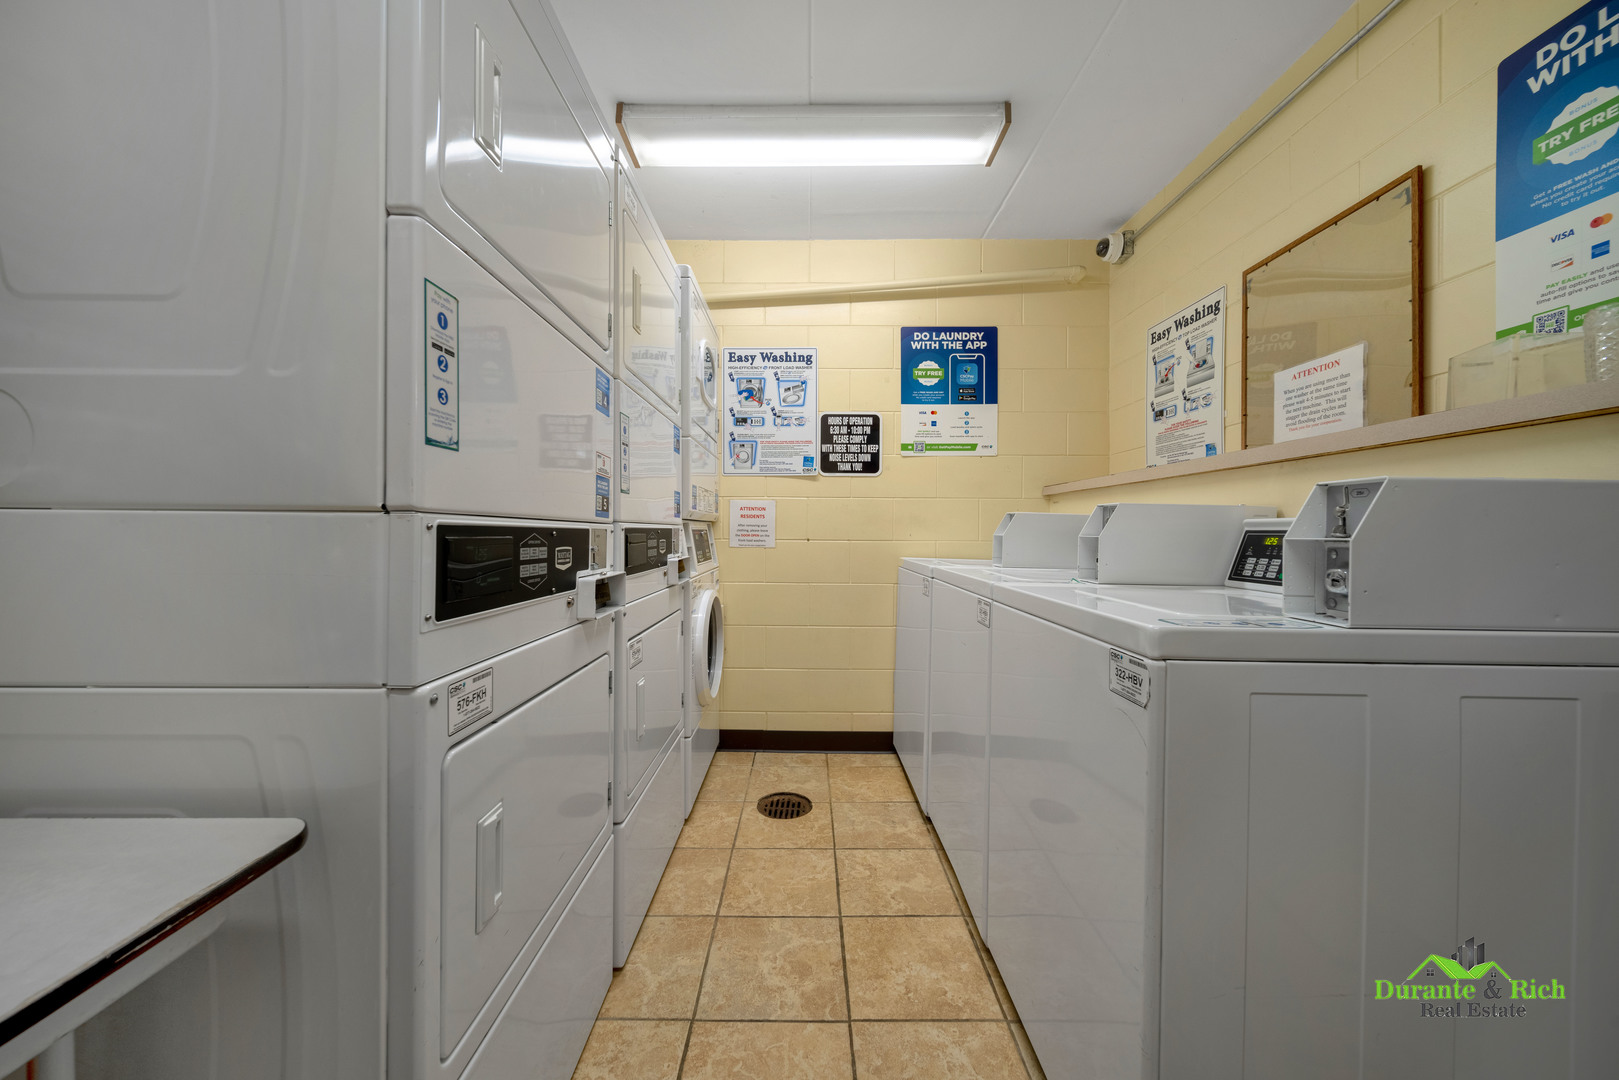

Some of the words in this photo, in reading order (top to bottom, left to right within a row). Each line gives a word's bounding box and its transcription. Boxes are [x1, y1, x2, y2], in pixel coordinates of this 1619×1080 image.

[1536, 24, 1586, 70] DO
[1526, 23, 1619, 94] WITH
[1569, 97, 1598, 116] BONUS
[1538, 127, 1574, 153] TRY
[1569, 140, 1597, 156] BONUS
[1530, 197, 1548, 207] when
[1550, 191, 1563, 199] you
[1565, 180, 1587, 192] create
[1589, 171, 1606, 182] your
[1533, 192, 1545, 200] Get
[1553, 179, 1573, 191] FREE
[1574, 167, 1599, 181] WASH
[1590, 185, 1605, 195] out.
[1554, 191, 1574, 203] credit
[1576, 183, 1592, 194] card
[1551, 229, 1575, 243] VISA
[1546, 282, 1560, 290] PAY
[1561, 272, 1588, 284] EASILY
[1590, 266, 1605, 276] and
[1540, 286, 1567, 298] auto-fill
[1568, 277, 1596, 289] options
[1553, 291, 1566, 300] and
[1568, 287, 1583, 297] give
[1585, 283, 1599, 291] you
[1151, 326, 1172, 345] Easy
[1174, 300, 1221, 332] Washing
[914, 332, 930, 340] DO
[932, 332, 984, 340] LAUNDRY
[440, 357, 446, 370] 2
[728, 352, 757, 365] Easy
[760, 351, 813, 365] Washing
[1291, 359, 1340, 381] ATTENTION
[440, 390, 446, 402] 3
[828, 417, 842, 425] HOURS
[843, 417, 848, 425] OF
[849, 417, 873, 425] OPERATION
[830, 426, 839, 434] 6:30
[840, 426, 847, 434] AM
[851, 426, 862, 434] 10:00
[864, 426, 871, 434] PM
[833, 435, 849, 443] PLEASE
[850, 435, 867, 443] COMPLY
[822, 444, 832, 452] WITH
[834, 444, 846, 452] THESE
[848, 444, 860, 452] TIMES
[861, 444, 867, 452] TO
[829, 454, 841, 462] NOISE
[842, 454, 857, 462] LEVELS
[858, 454, 871, 462] DOWN
[838, 463, 851, 471] THANK
[1115, 667, 1143, 687] 322-HBV
[457, 688, 487, 711] 576-FKH
